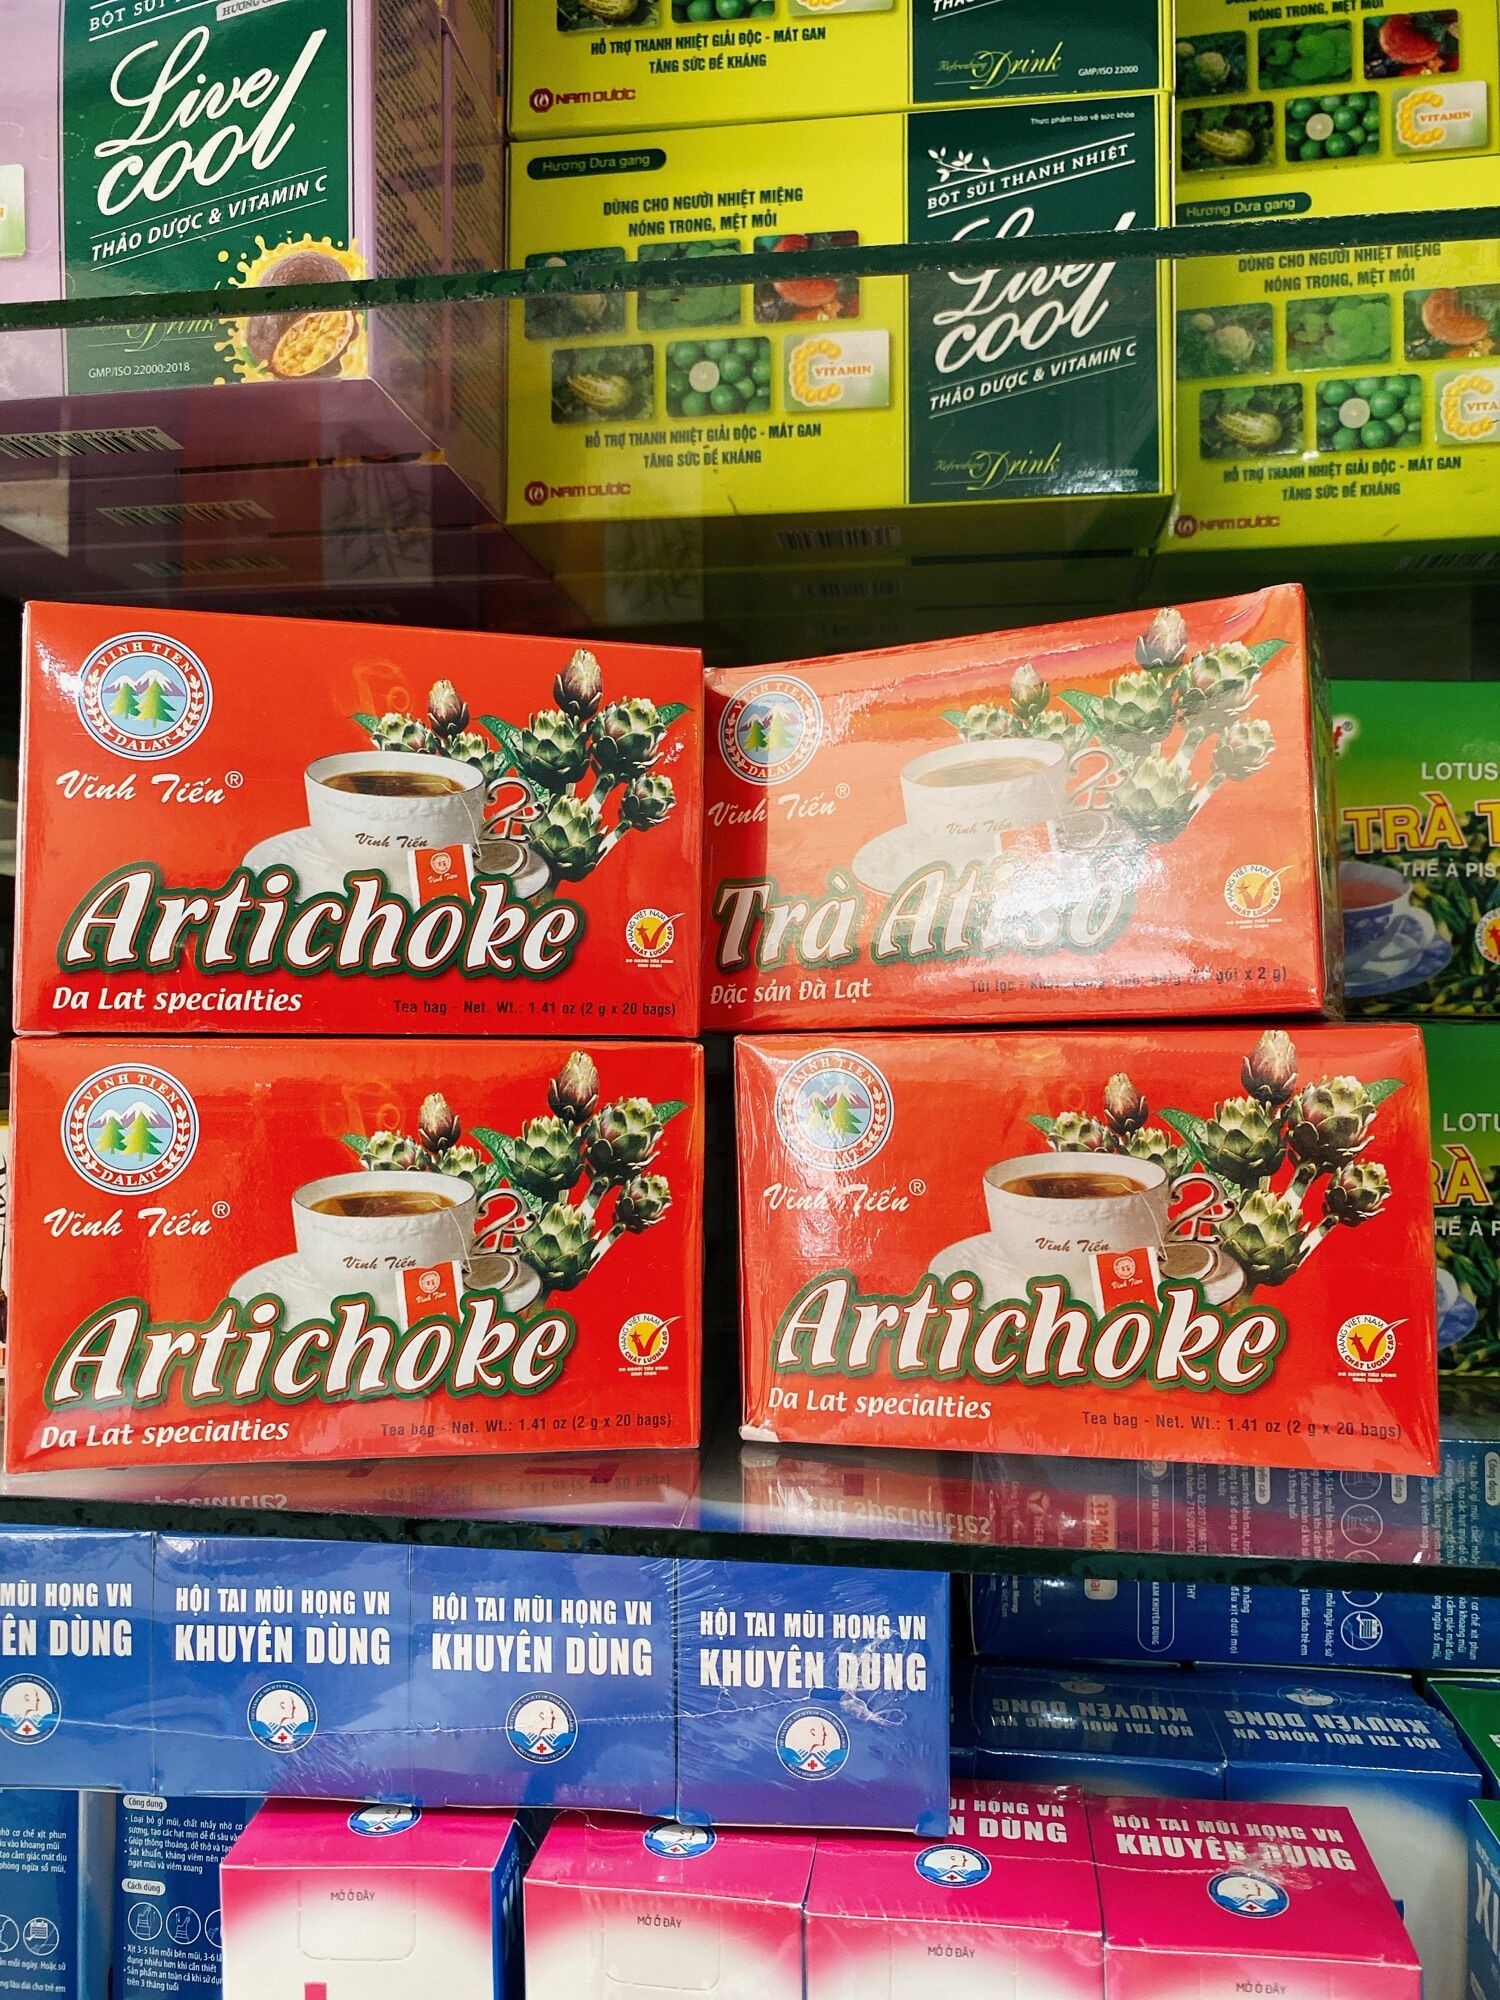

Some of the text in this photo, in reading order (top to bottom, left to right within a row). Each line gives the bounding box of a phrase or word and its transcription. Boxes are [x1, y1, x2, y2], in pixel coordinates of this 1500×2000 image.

[89, 8, 125, 33] BỘT
[610, 39, 631, 56] TRỢ
[635, 38, 673, 52] THANH
[676, 33, 708, 51] NHIỆT
[712, 29, 735, 46] GIẢI
[739, 29, 761, 45] ĐỘC
[774, 27, 798, 42] MÁT
[802, 27, 826, 41] GAN
[649, 59, 679, 74] TĂNG
[683, 56, 705, 71] SỨC
[727, 52, 766, 68] KHÁNG
[969, 41, 1064, 90] Drink
[1078, 64, 1138, 77] GMP/ISO 22000
[95, 26, 279, 157] Live
[556, 90, 590, 105] NAM
[97, 29, 327, 216] cool
[1420, 110, 1471, 122] VITAMIN
[543, 155, 651, 174] Hương Dưa gang
[927, 144, 1129, 211] BỘT SỦI THANH NHIỆT
[604, 186, 804, 216] DÙNG CHO NGƯỜI NHIỆT MIỆNG
[1186, 199, 1295, 216] Hương Dưa gang
[91, 174, 328, 262] THẢO DƯỢC & VITAMIN C
[629, 209, 777, 237] NÓNG TRONG, MỆT MỎI
[1264, 263, 1415, 292] NÓNG TRONG, MỆT MỎI
[88, 361, 190, 379] GMP/ISO 22000:2018
[815, 364, 872, 377] VITAMIN
[929, 342, 1137, 411] THẢO DƯỢC & VITAMIN C
[643, 452, 673, 469] TĂNG
[677, 451, 700, 467] SỨC
[722, 448, 762, 465] KHÁNG
[967, 441, 1063, 491] Drink
[551, 485, 587, 499] NAM
[97, 641, 194, 674] VINH TIEN
[115, 734, 173, 752] DALAT
[56, 769, 137, 801] Vĩnh
[1422, 762, 1499, 781] LOTUS
[708, 799, 767, 827] Vĩnh
[1342, 791, 1467, 854] TRÀ
[1401, 857, 1459, 877] THÉ À
[62, 866, 582, 972] Artichoke
[715, 869, 860, 969] Trà
[52, 986, 303, 1014] Da Lat specialties
[710, 977, 872, 1008] Đặc sản Đà Lạt
[84, 1073, 180, 1104] VINH TIEN
[99, 1169, 159, 1186] DALAT
[763, 1183, 829, 1212] Vĩnh
[43, 1207, 124, 1238] Vĩnh
[773, 1276, 1281, 1389] Artichoke
[48, 1297, 573, 1407] Artichoke
[769, 1387, 992, 1419] Da Lat specialties
[41, 1418, 290, 1449] Da Lat specialties
[1082, 1411, 1107, 1425] Tea
[1113, 1411, 1138, 1429] bag
[1156, 1414, 1184, 1428] Net.
[1228, 1418, 1257, 1432] 1.41
[1265, 1421, 1281, 1433] oz
[1287, 1420, 1301, 1437] (2
[1308, 1425, 1316, 1437] g
[1322, 1424, 1330, 1434] x
[1336, 1422, 1354, 1436] 20
[1361, 1422, 1401, 1440] bags)
[176, 1583, 390, 1619] HỘI TAI MŨI HỌNG VN
[433, 1592, 652, 1628] HỘI TAI MŨI HỌNG VN
[175, 1620, 391, 1666] KHUYÊN DÙNG
[432, 1629, 652, 1677] KHUYÊN DÙNG
[128, 1797, 145, 1808] Công
[1113, 1814, 1150, 1831] HỘI
[1156, 1818, 1190, 1832] TAI
[1246, 1823, 1307, 1842] HỌNG
[1311, 1827, 1345, 1843] VN
[1115, 1833, 1248, 1863] KHUYÊN
[127, 1881, 142, 1892] Cách
[355, 1890, 376, 1902] ĐÂY
